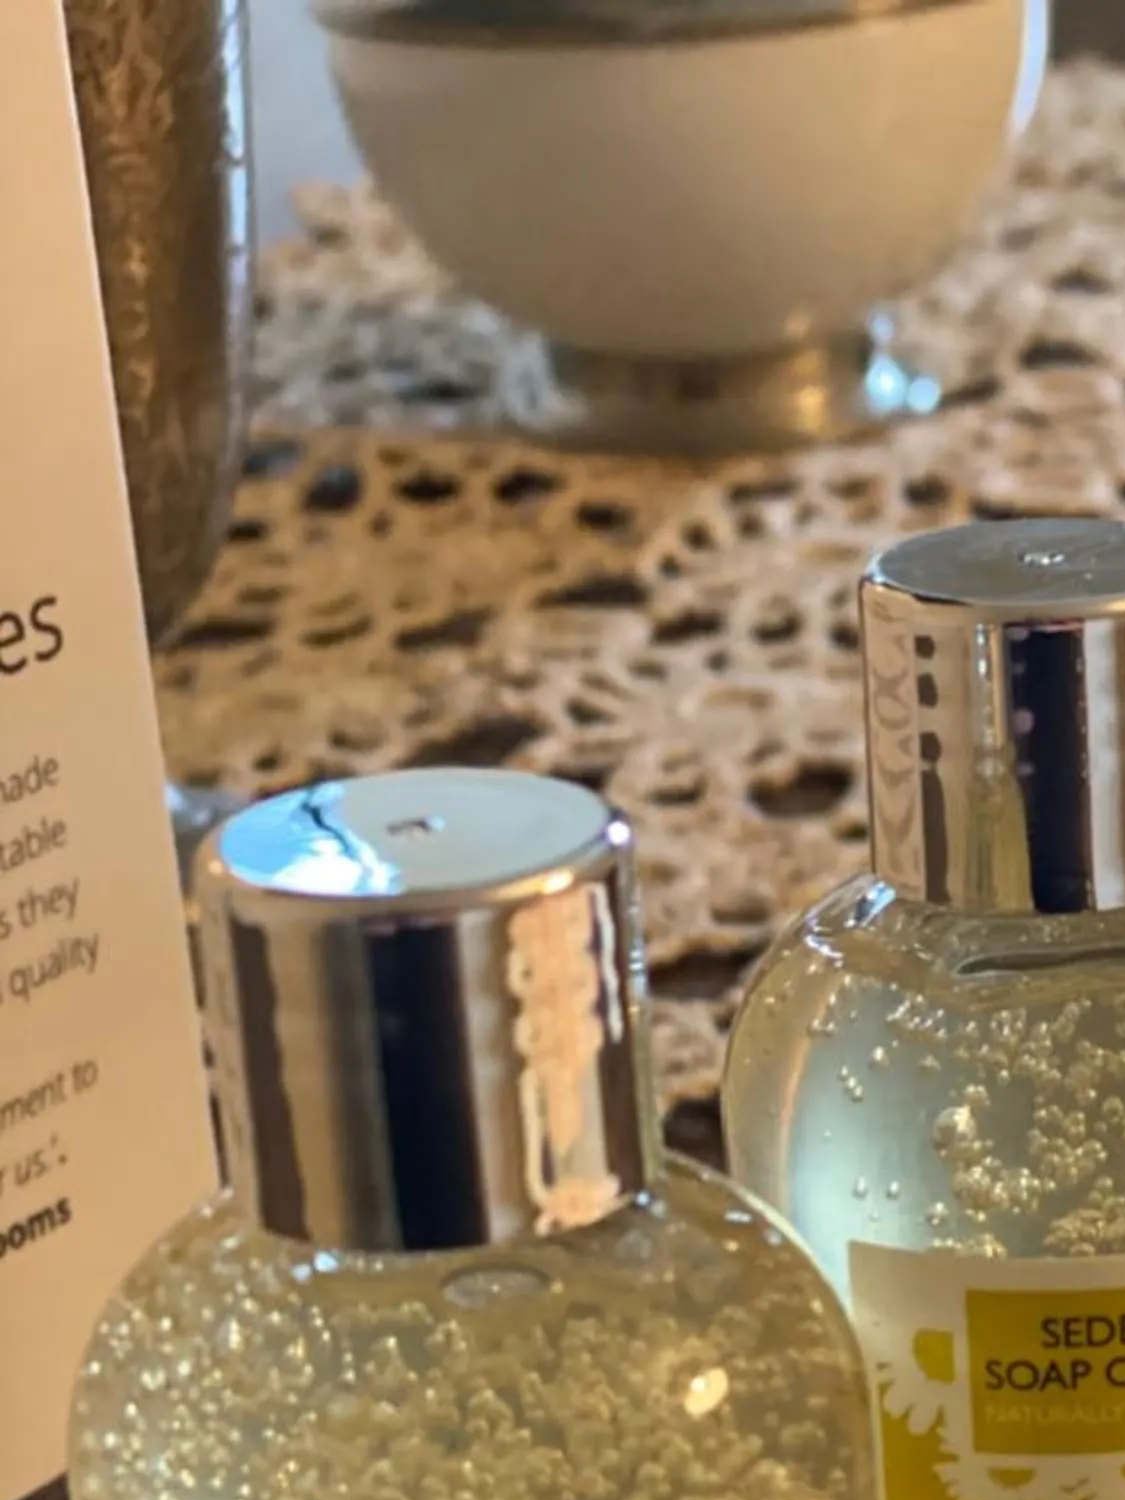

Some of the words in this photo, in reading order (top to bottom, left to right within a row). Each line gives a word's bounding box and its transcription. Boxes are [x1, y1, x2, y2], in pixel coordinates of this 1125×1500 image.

[17, 875, 80, 929] they
[9, 932, 99, 1003] quality
[71, 1058, 99, 1094] to
[985, 1359, 1092, 1391] SOAP
